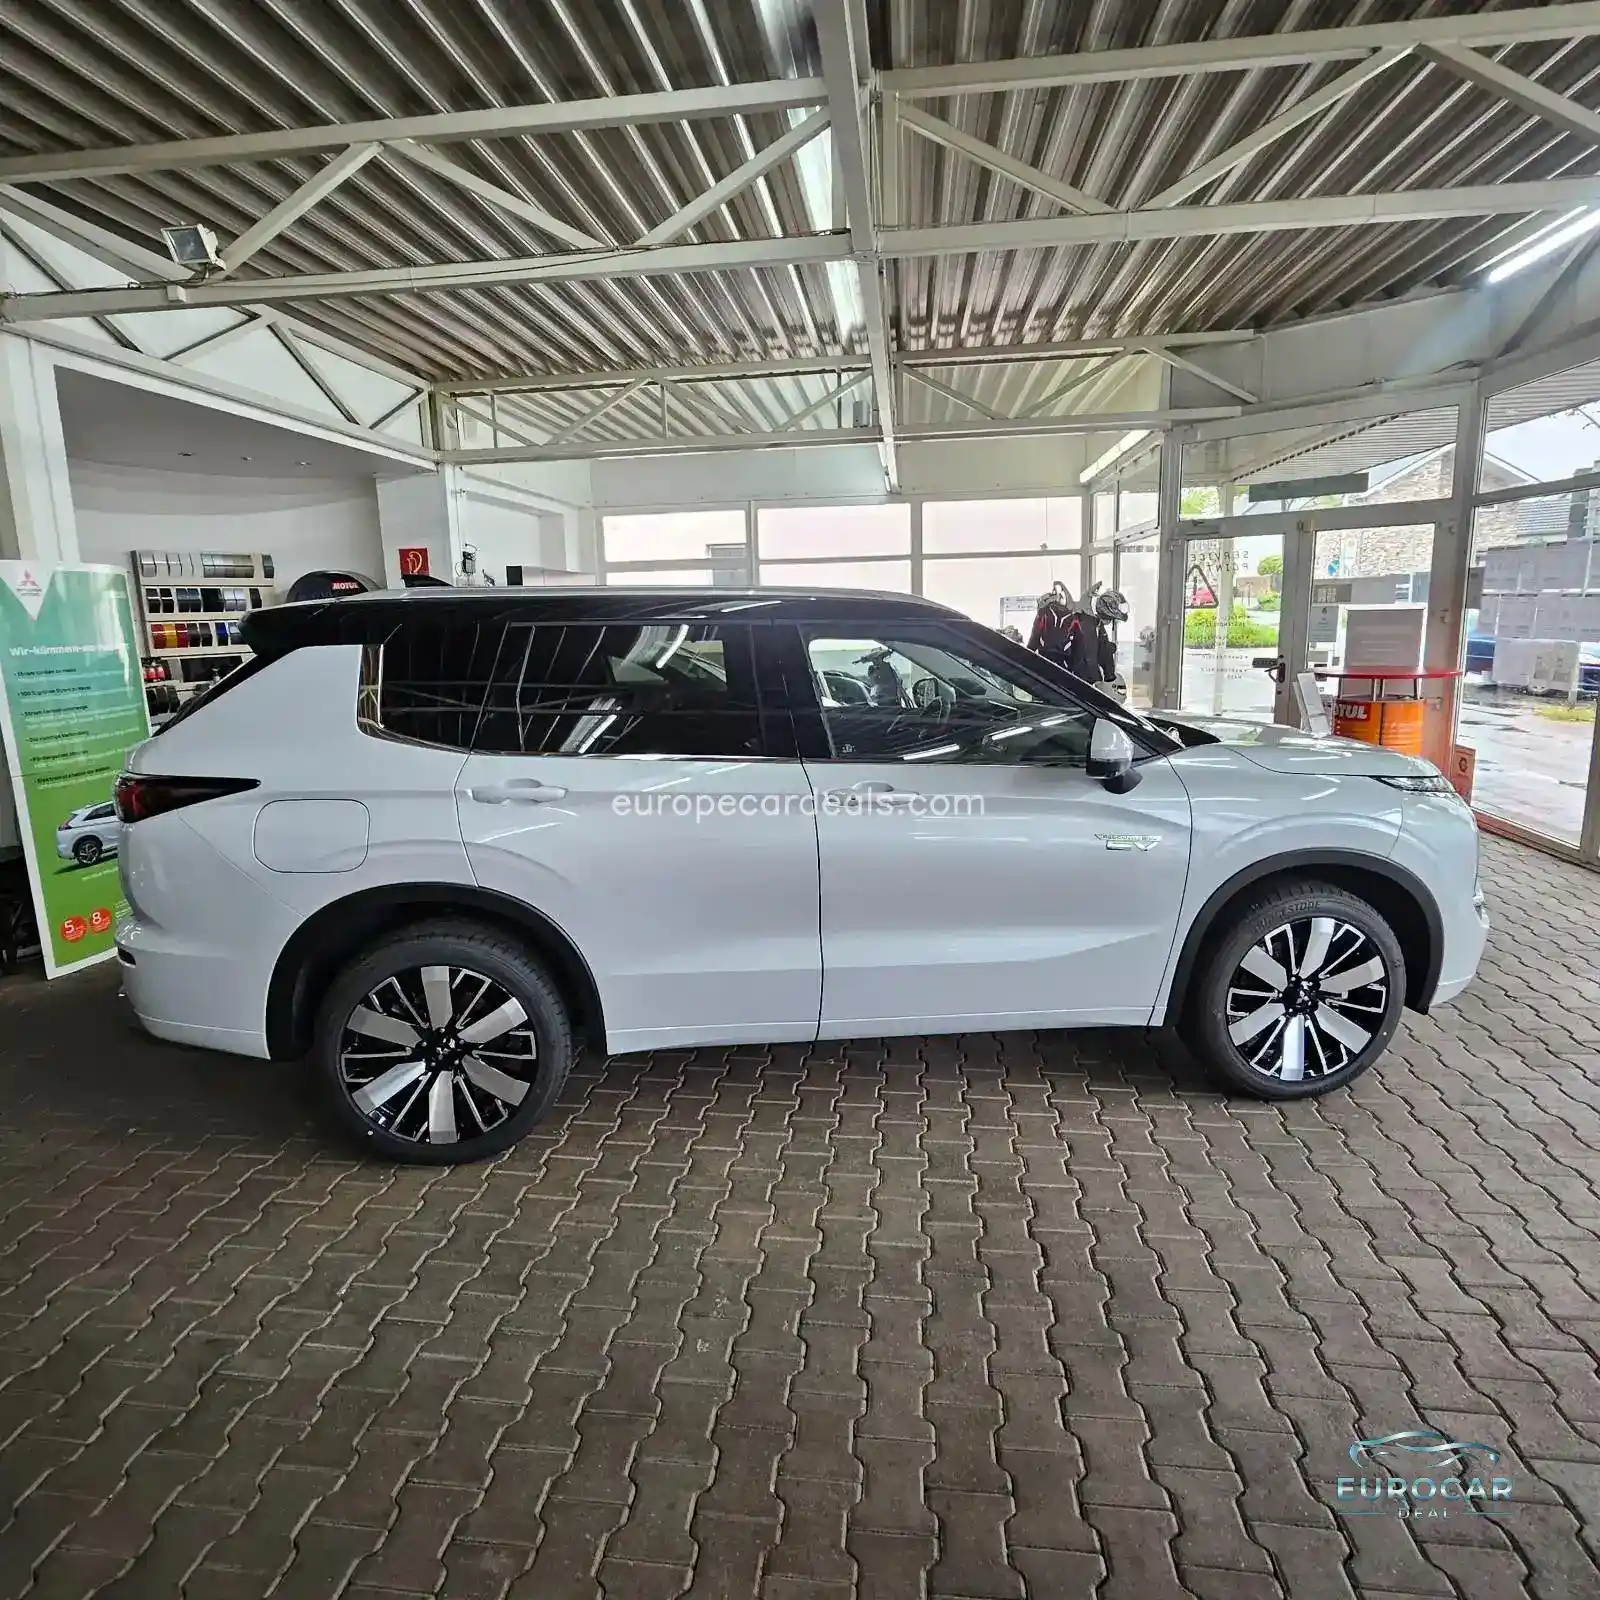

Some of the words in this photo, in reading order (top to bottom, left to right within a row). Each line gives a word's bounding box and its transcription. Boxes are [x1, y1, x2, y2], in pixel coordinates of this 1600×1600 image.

[332, 582, 360, 590] MOTUL
[92, 911, 102, 925] 8
[64, 919, 75, 934] 5
